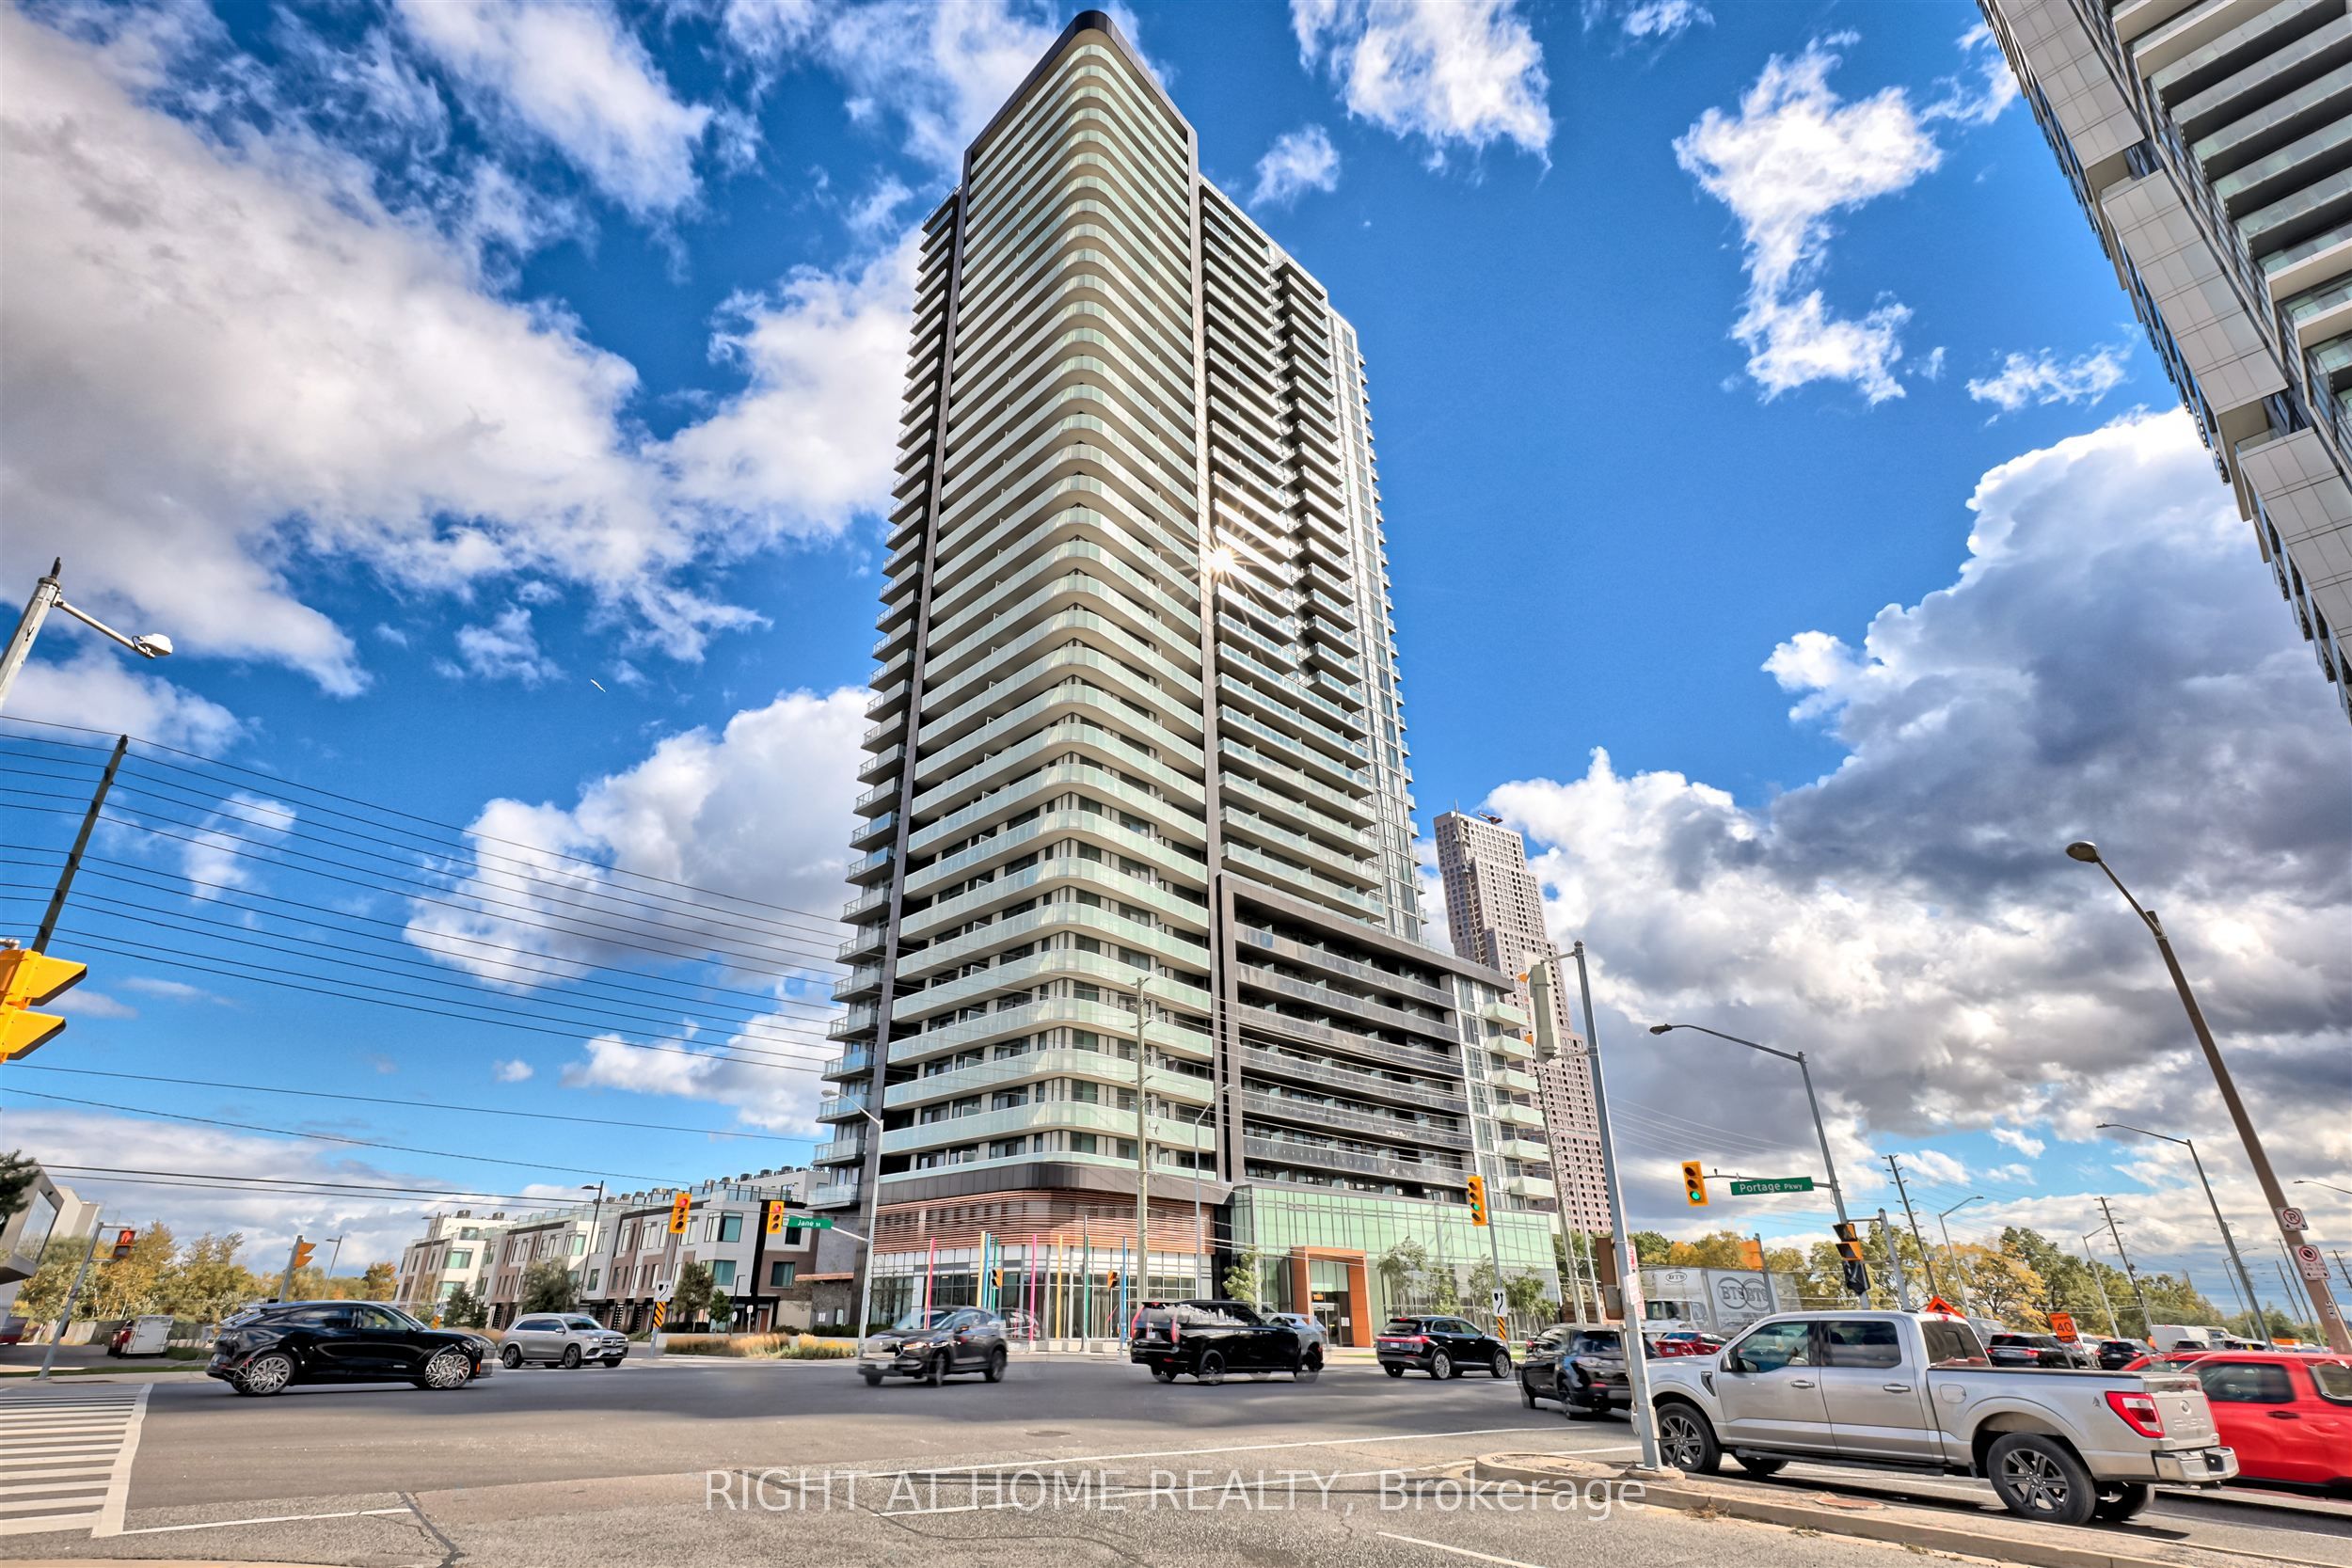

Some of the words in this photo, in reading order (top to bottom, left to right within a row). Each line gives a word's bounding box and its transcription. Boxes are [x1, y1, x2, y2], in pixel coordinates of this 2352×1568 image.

[1740, 1183, 1781, 1193] Portage
[1721, 1286, 1744, 1300] BTS
[2058, 1323, 2073, 1332] 40
